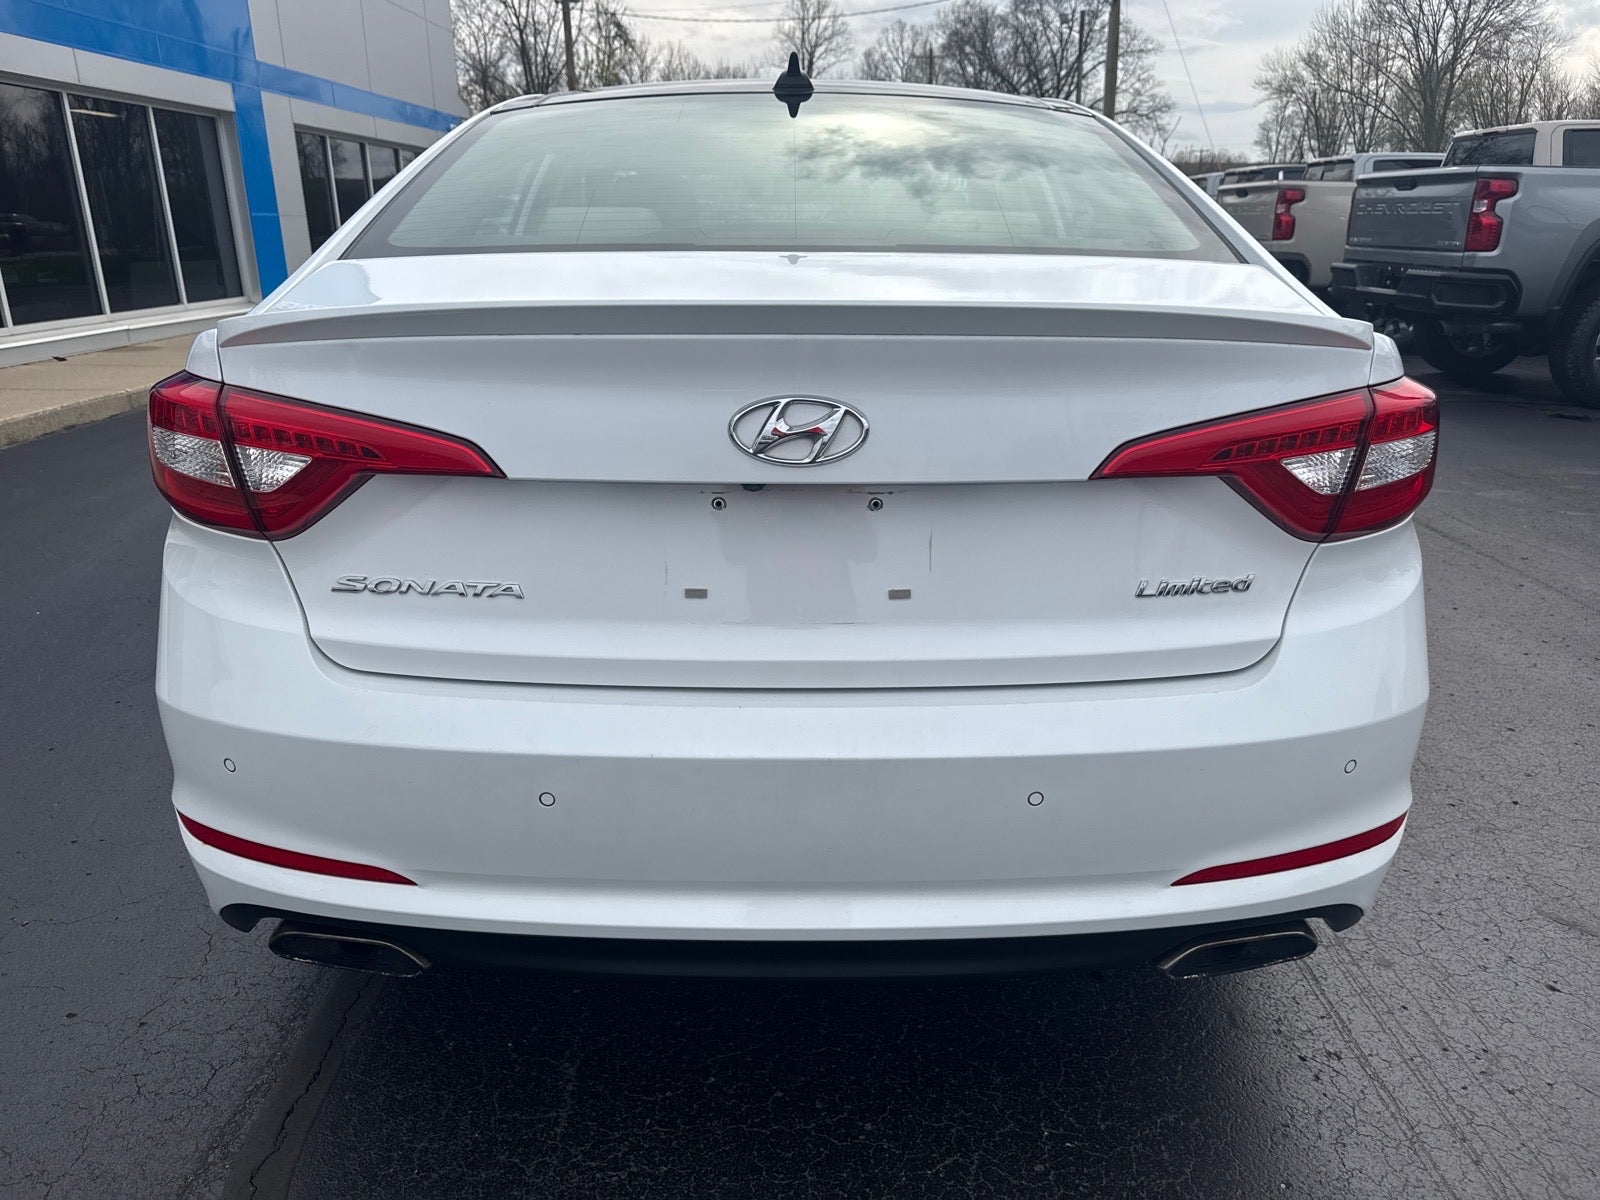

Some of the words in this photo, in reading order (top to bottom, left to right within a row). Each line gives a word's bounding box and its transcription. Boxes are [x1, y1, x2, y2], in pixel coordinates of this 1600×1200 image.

[1356, 201, 1460, 215] CHEVROLET
[331, 575, 524, 599] SONATA
[1135, 573, 1255, 598] Limited
